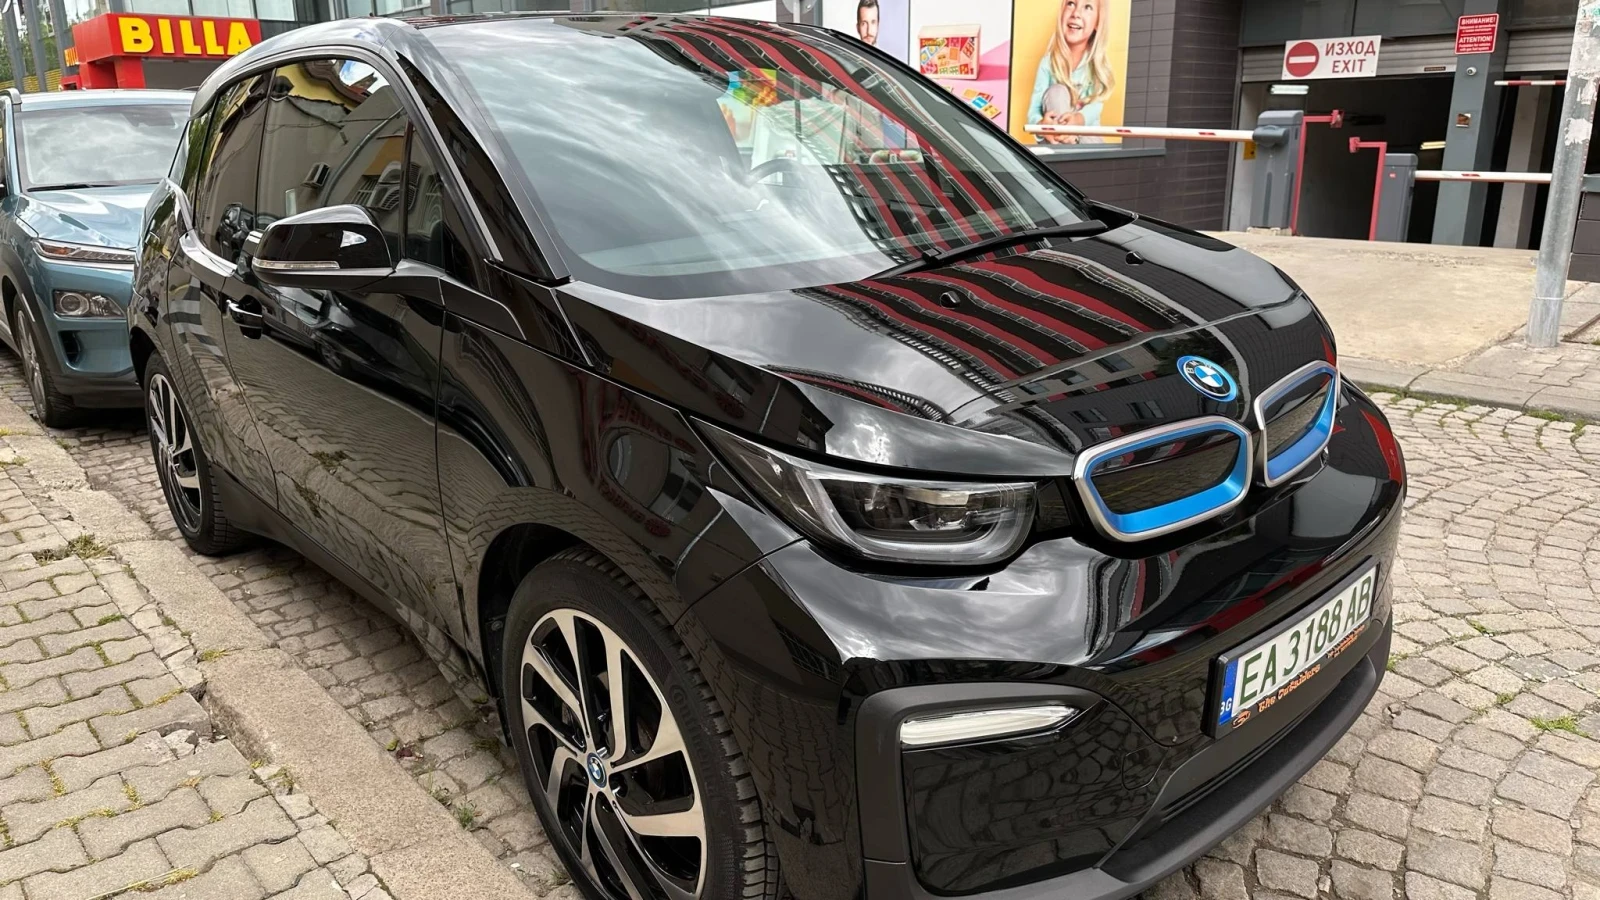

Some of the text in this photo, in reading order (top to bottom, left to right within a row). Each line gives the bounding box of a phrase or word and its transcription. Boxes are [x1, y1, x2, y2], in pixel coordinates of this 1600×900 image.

[1461, 17, 1496, 25] ВНИМАНИЕ!
[118, 17, 253, 56] BILLA
[1458, 35, 1492, 43] ATTENTION!
[1325, 40, 1376, 57] ИЗХОД
[1332, 59, 1367, 74] EXIT
[1239, 643, 1277, 706] EA
[1282, 598, 1343, 677] 3188
[1343, 575, 1372, 633] AB
